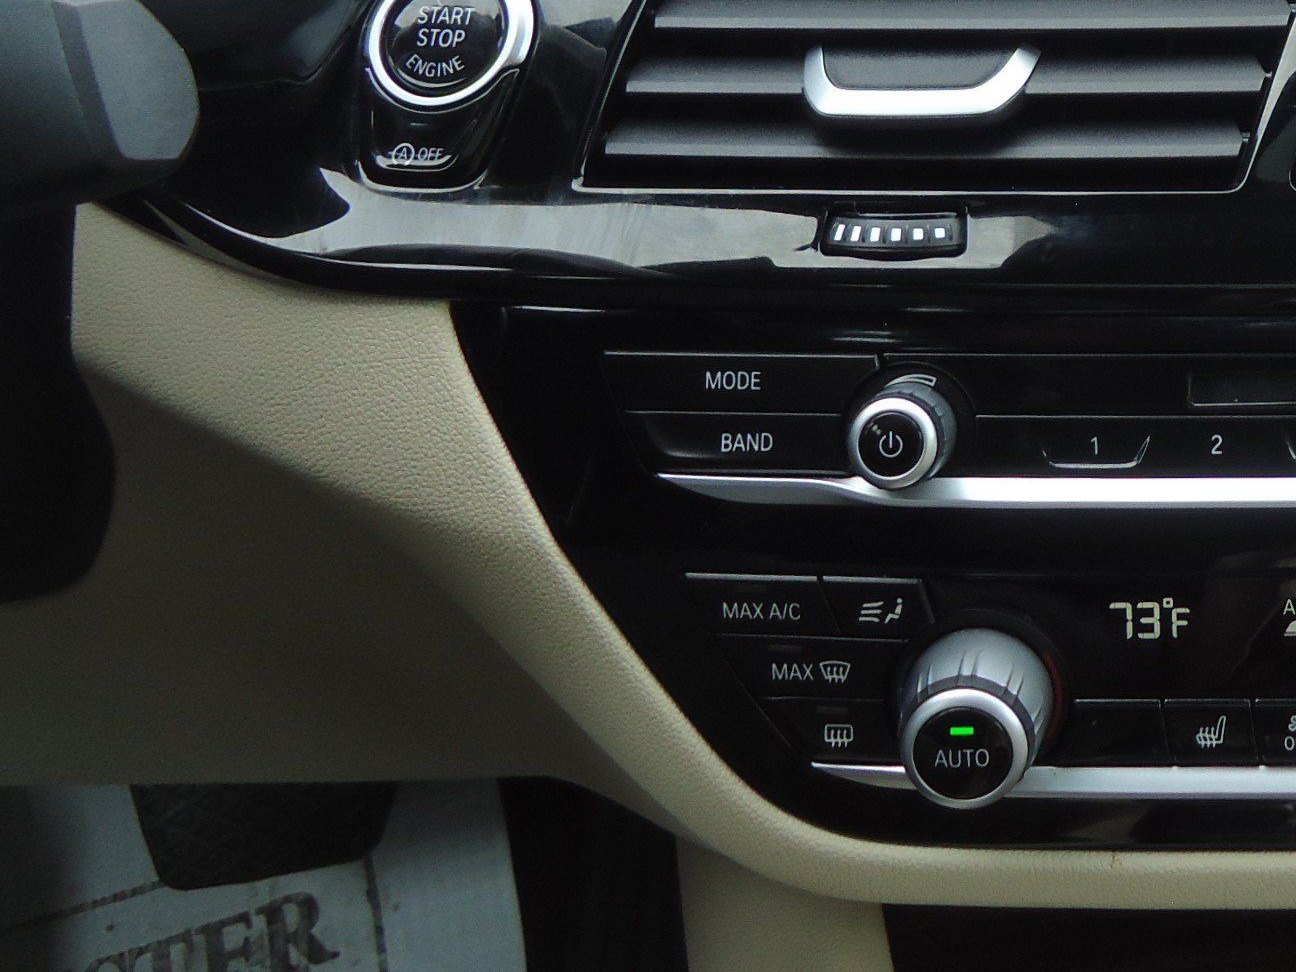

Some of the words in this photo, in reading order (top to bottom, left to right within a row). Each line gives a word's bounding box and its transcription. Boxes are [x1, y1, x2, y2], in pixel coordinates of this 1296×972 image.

[417, 5, 475, 26] START
[416, 28, 466, 48] STOP
[405, 54, 465, 78] ENGINE
[417, 148, 443, 161] OFF
[705, 371, 762, 392] MODE
[720, 433, 774, 453] BAND
[1090, 437, 1099, 454] 1
[1210, 435, 1223, 455] 2
[722, 602, 763, 620] MAX
[769, 602, 801, 621] A/C
[771, 662, 814, 681] MAX
[934, 749, 990, 769] AUTO
